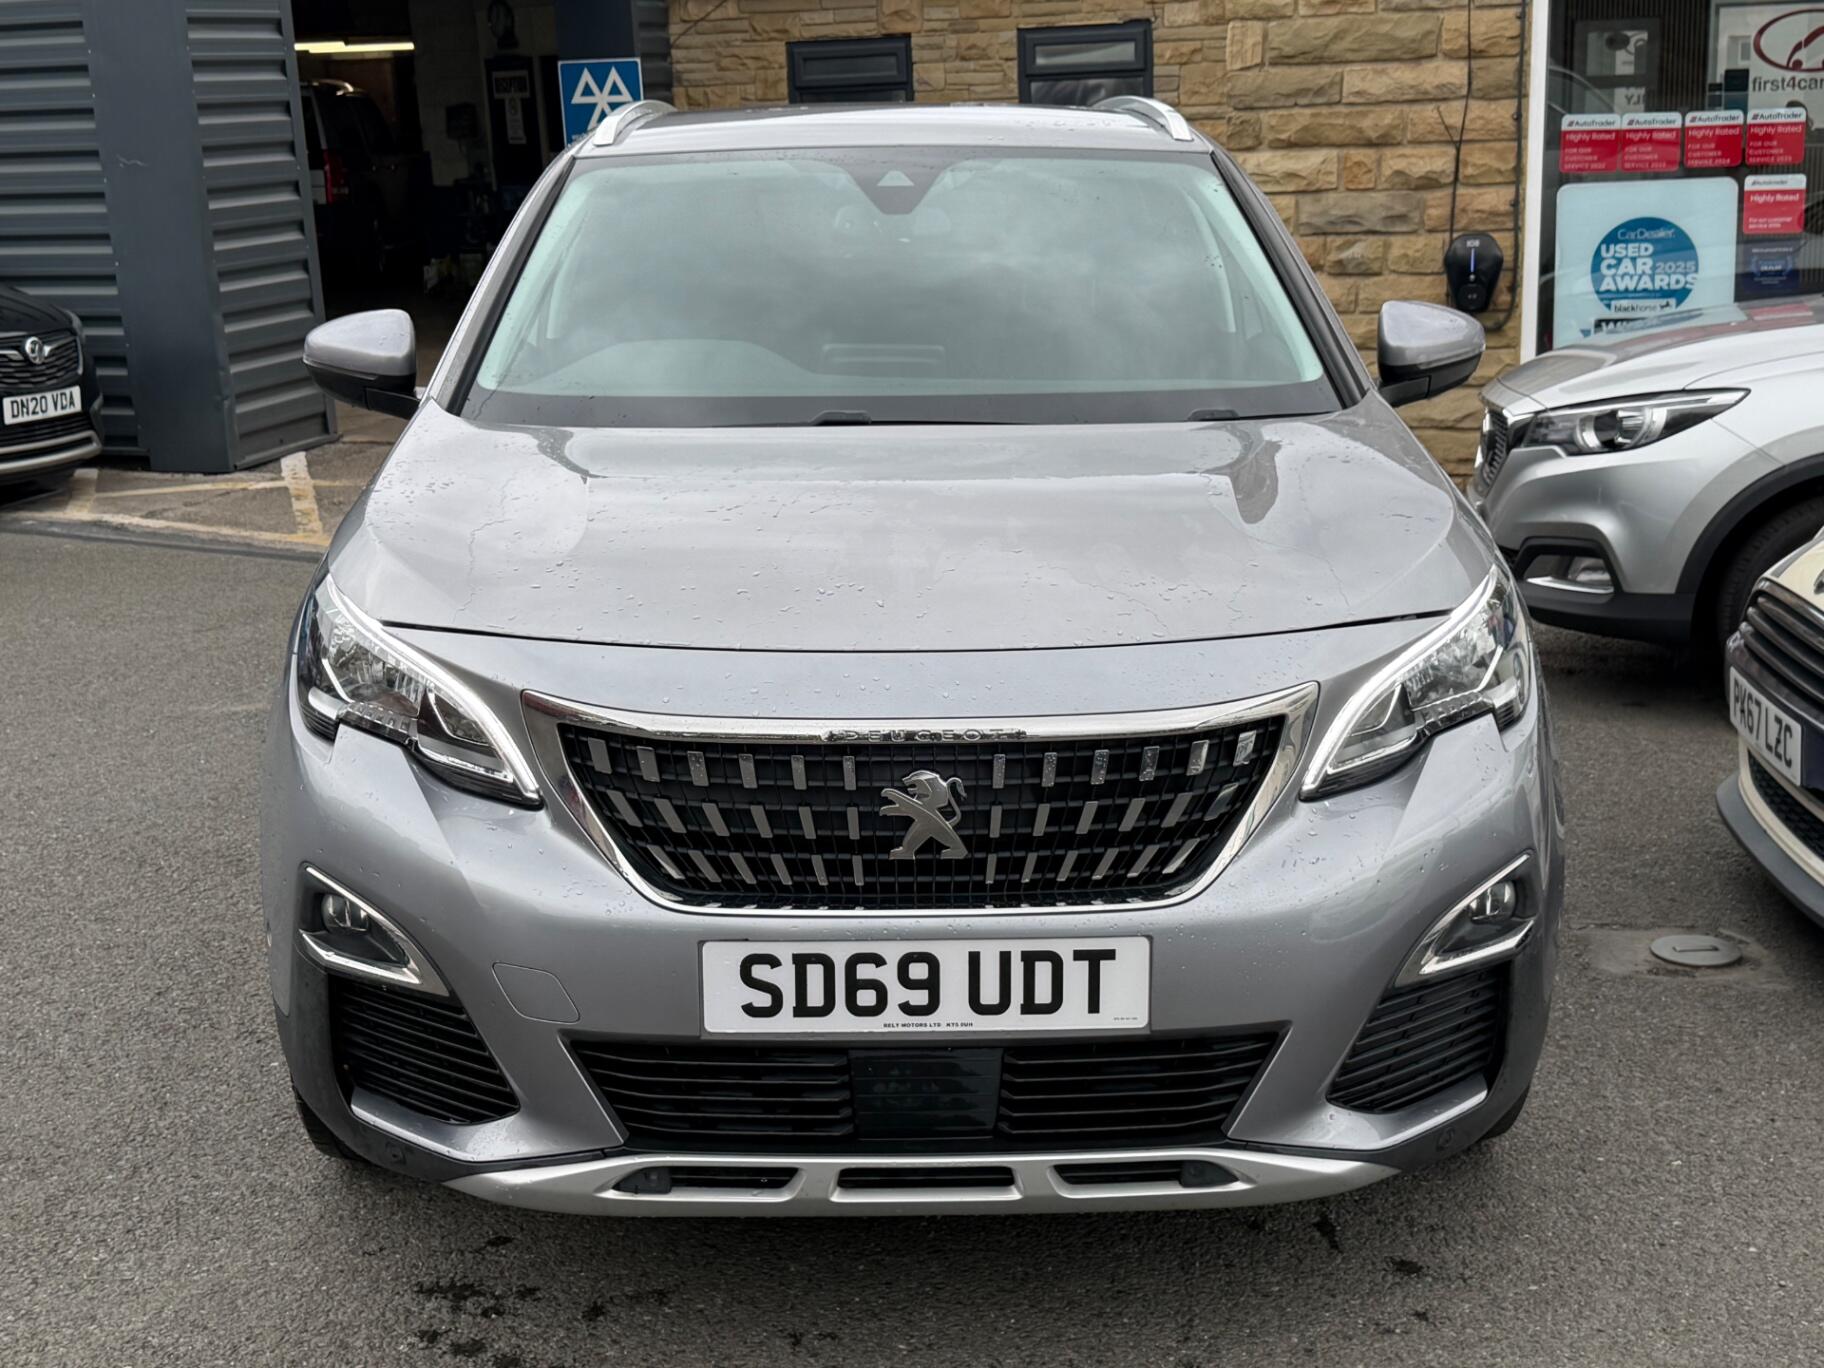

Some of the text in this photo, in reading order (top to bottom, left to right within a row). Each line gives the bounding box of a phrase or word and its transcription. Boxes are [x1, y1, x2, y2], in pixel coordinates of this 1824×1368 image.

[1634, 118, 1676, 126] AutoTrader
[1698, 114, 1740, 122] AutoTrader
[1759, 112, 1802, 120] AutoTrader
[1574, 119, 1616, 127] AutoTrader
[1626, 130, 1676, 141] Highly Rated
[1688, 127, 1739, 138] Highly Rated
[1750, 124, 1802, 136] Highly Rated
[1566, 131, 1616, 142] Highly Rated
[1750, 192, 1800, 204] Highly Rated
[1600, 242, 1654, 259] USED
[1600, 258, 1697, 276] CAR 2025
[1600, 272, 1699, 292] AWARDS
[10, 390, 76, 418] DN20 VDA
[843, 729, 1005, 742] PEUGEOT
[1765, 706, 1793, 768] LZC
[739, 948, 1117, 1018] SD69 UDT
